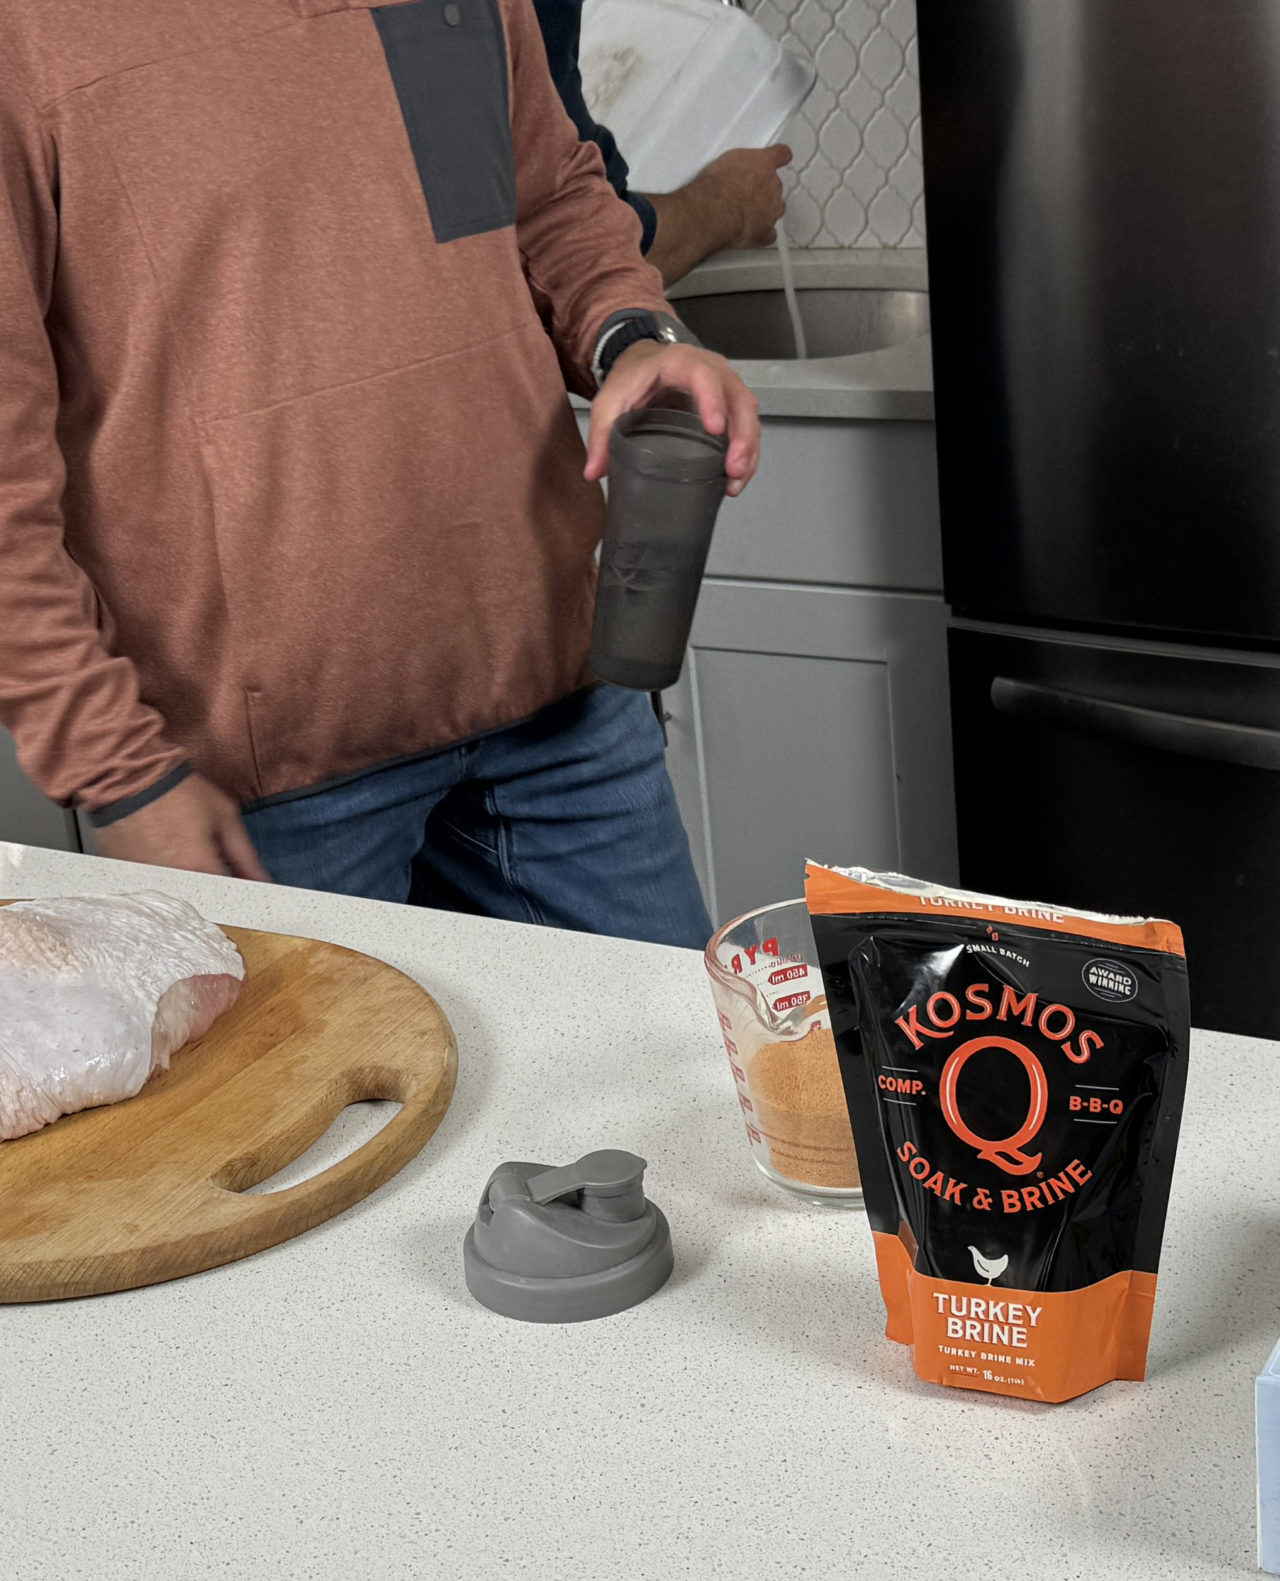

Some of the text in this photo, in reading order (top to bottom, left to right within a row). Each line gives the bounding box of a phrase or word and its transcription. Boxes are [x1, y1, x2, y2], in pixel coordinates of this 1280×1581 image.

[966, 943, 1030, 968] SMALL BATCH
[1088, 973, 1131, 996] WINNING
[1089, 966, 1132, 985] AWARD
[894, 983, 1105, 1064] KOSMOS
[878, 1074, 926, 1095] COMP.
[939, 1035, 1049, 1176] Q
[1069, 1095, 1124, 1115] B-B-Q
[896, 1141, 1093, 1214] SOAK & BRINE
[933, 1292, 1042, 1327] TURKEY
[947, 1317, 1028, 1348] BRINE
[938, 1345, 1035, 1367] TURKEY BRINE MIX
[949, 1364, 965, 1372] NET
[982, 1369, 993, 1381] 16
